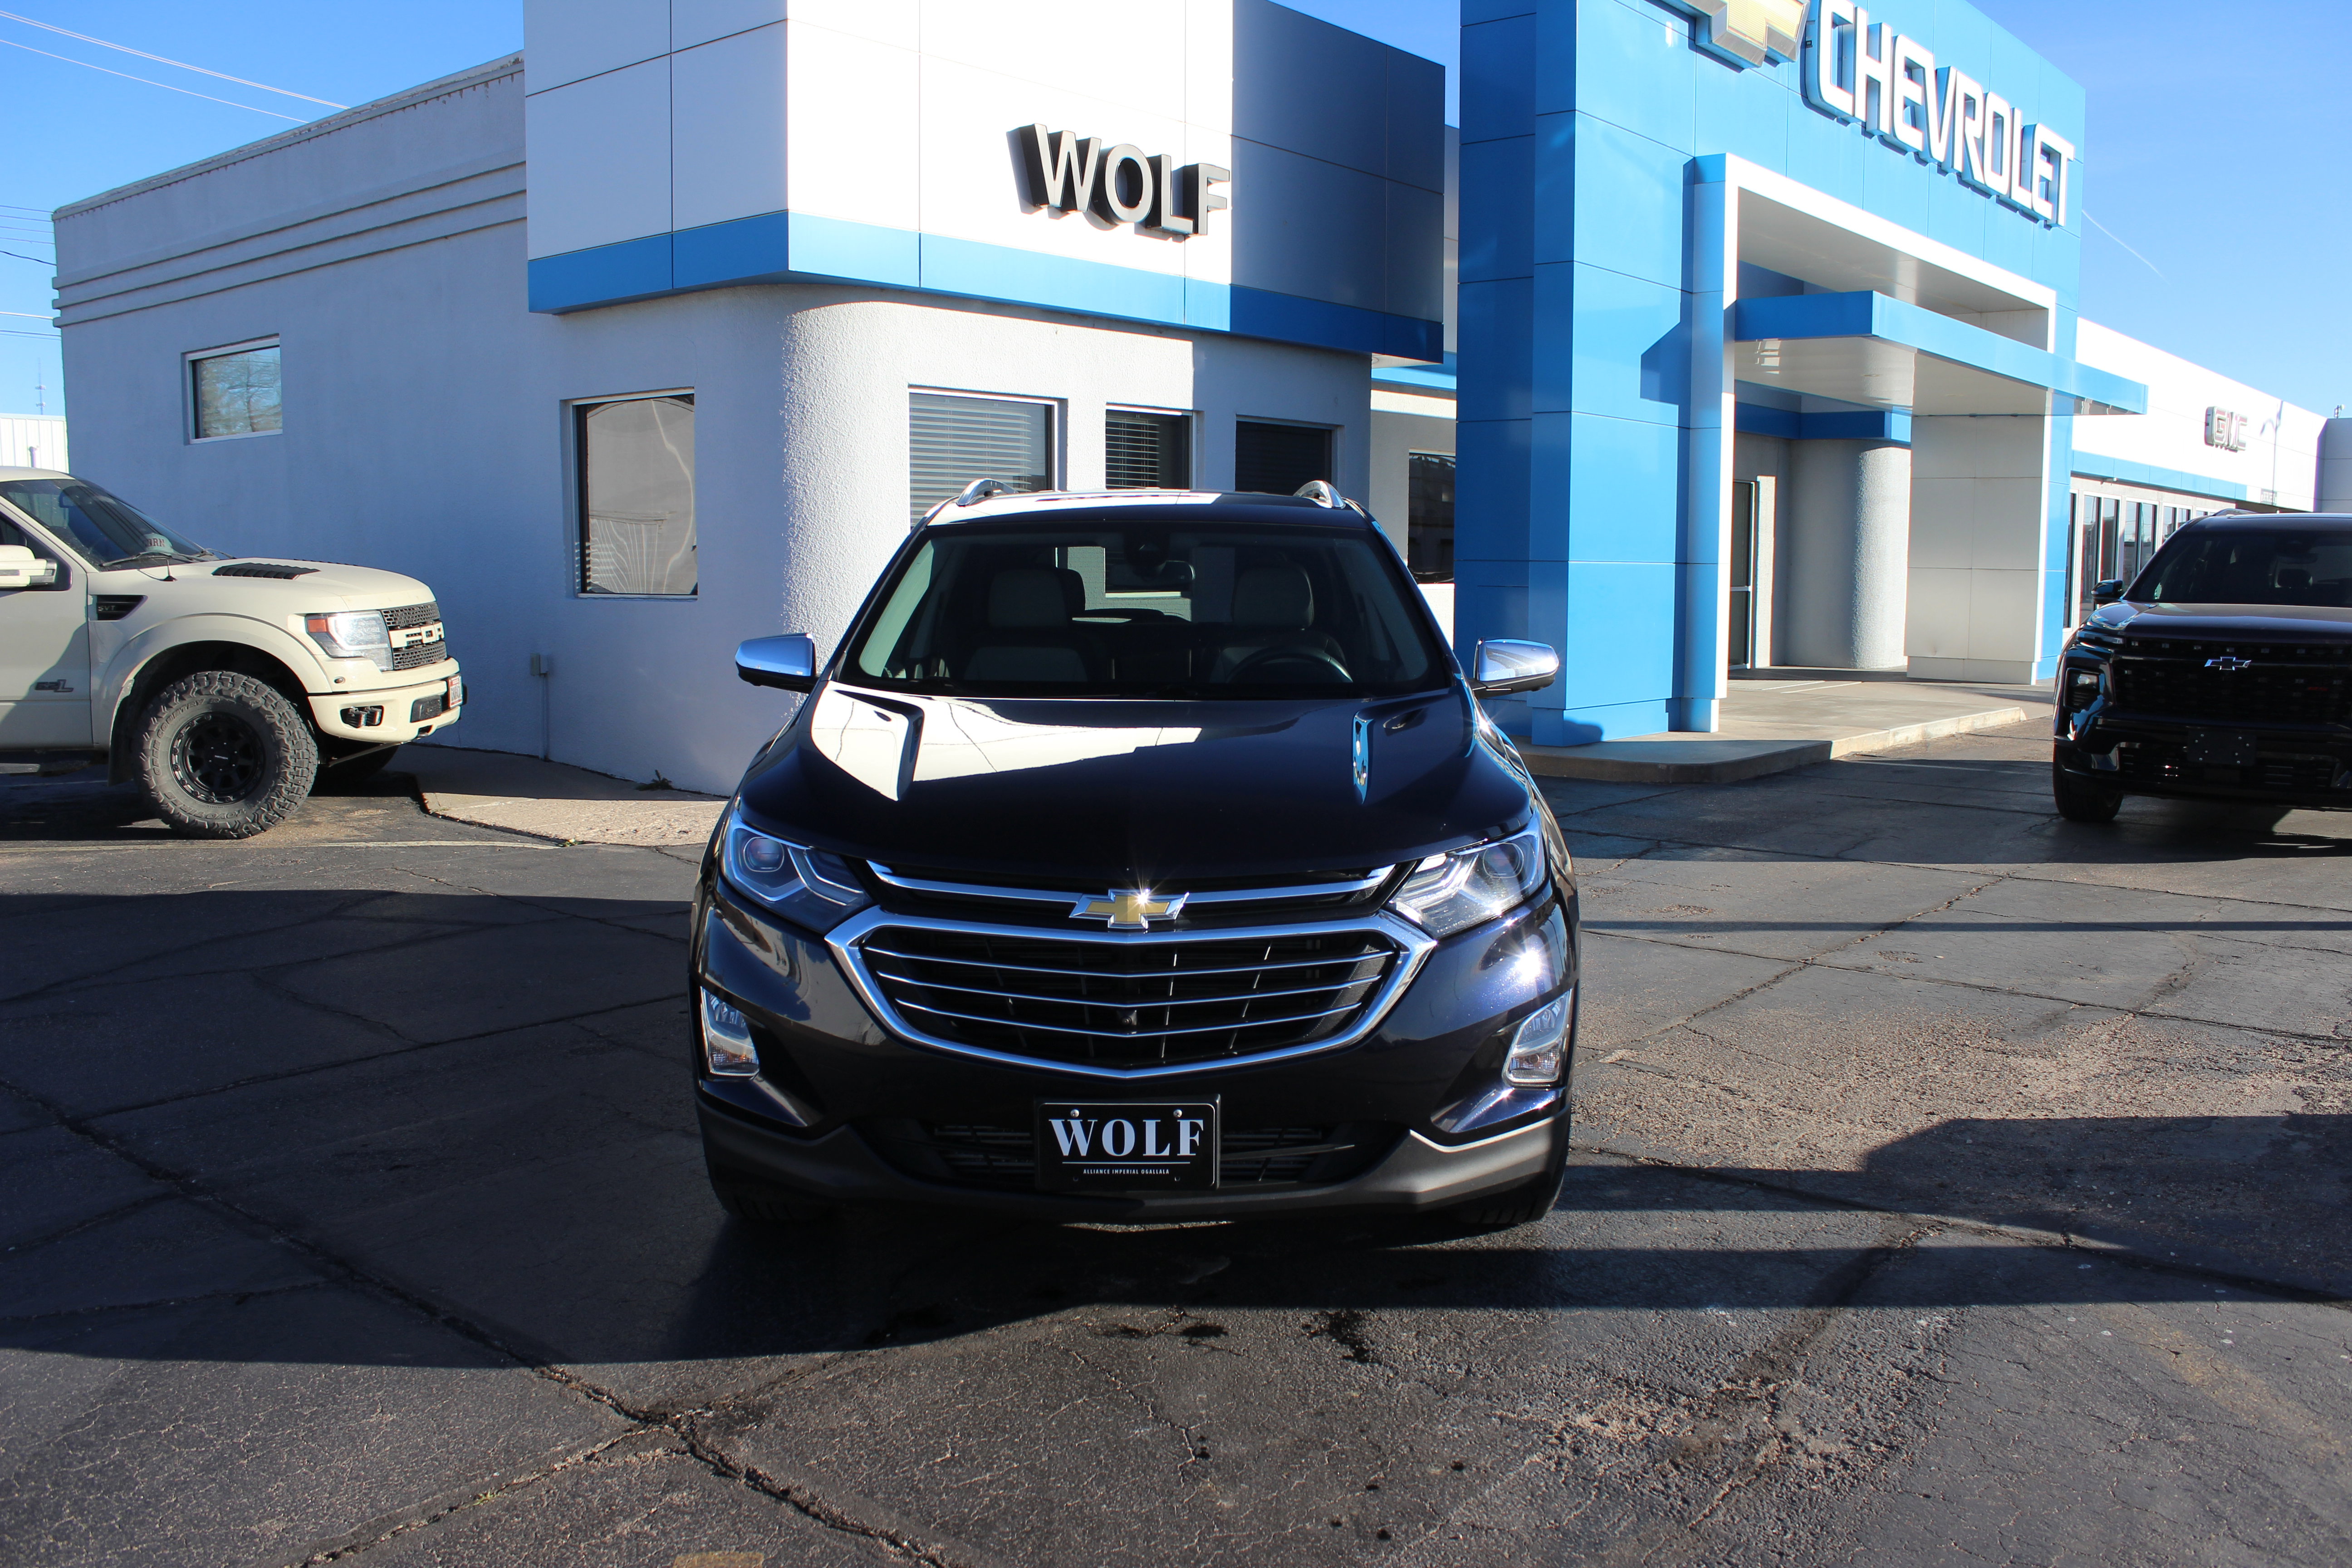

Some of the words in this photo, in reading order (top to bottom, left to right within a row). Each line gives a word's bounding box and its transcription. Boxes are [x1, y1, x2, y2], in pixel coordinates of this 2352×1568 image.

[1815, 0, 2076, 227] CHEVROLET
[1026, 123, 1230, 237] WOLF
[2209, 407, 2248, 451] GMC
[1049, 1119, 1204, 1156] WOLF
